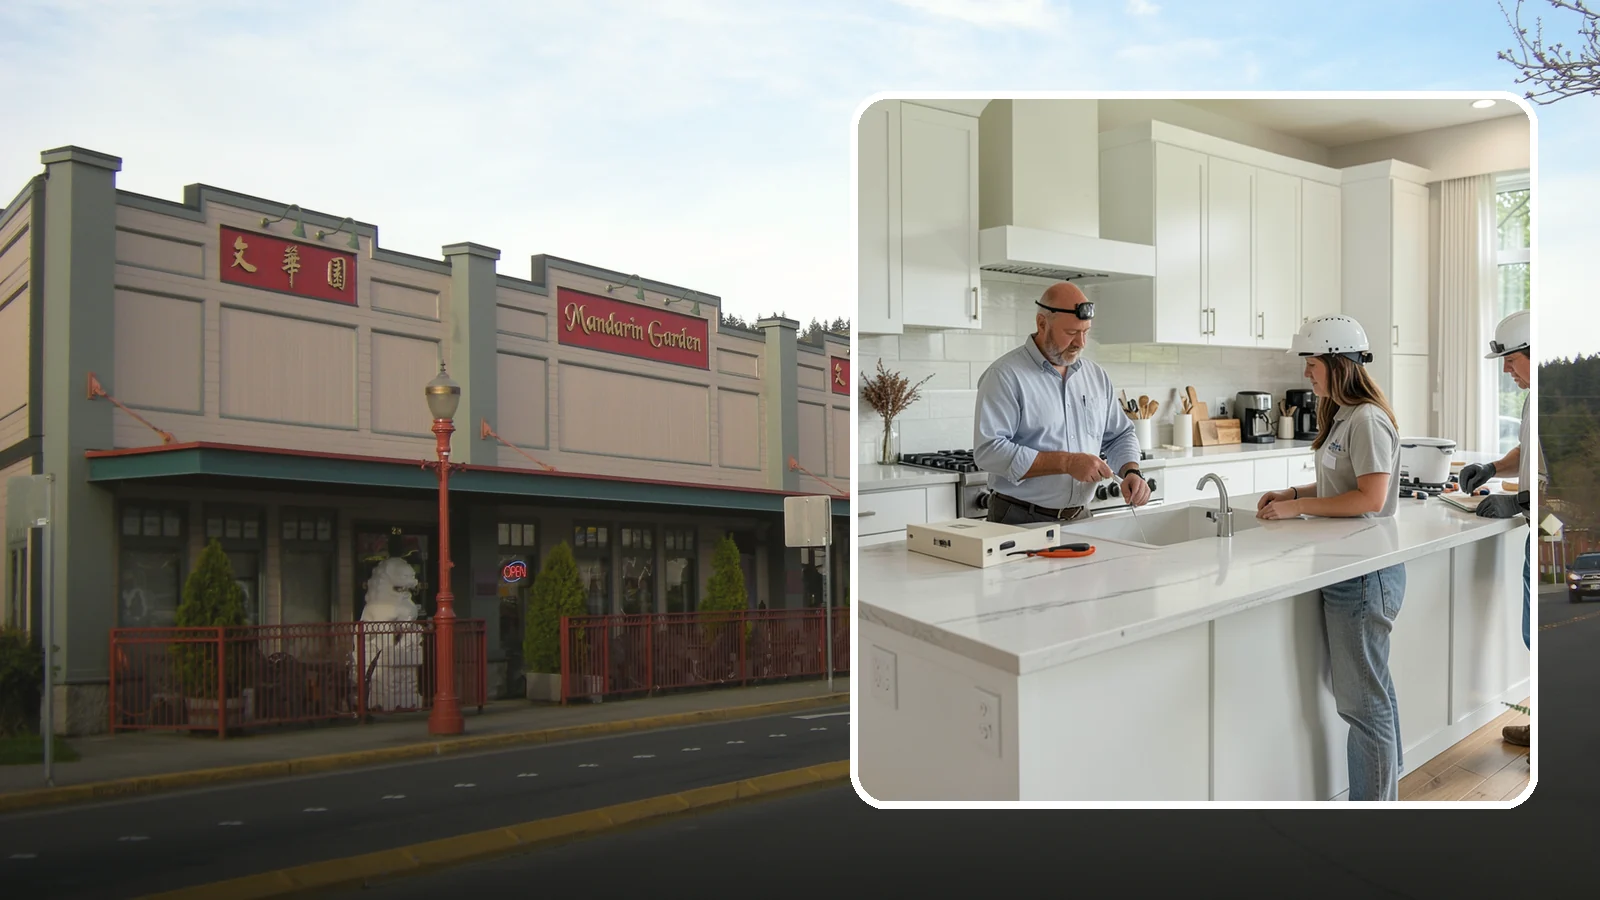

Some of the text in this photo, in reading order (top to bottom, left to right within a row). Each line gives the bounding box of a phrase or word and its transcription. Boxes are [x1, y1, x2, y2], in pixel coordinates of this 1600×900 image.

[231, 235, 346, 291] 文華園
[564, 302, 701, 352] Mandarin Garden
[503, 565, 527, 578] OPEN
